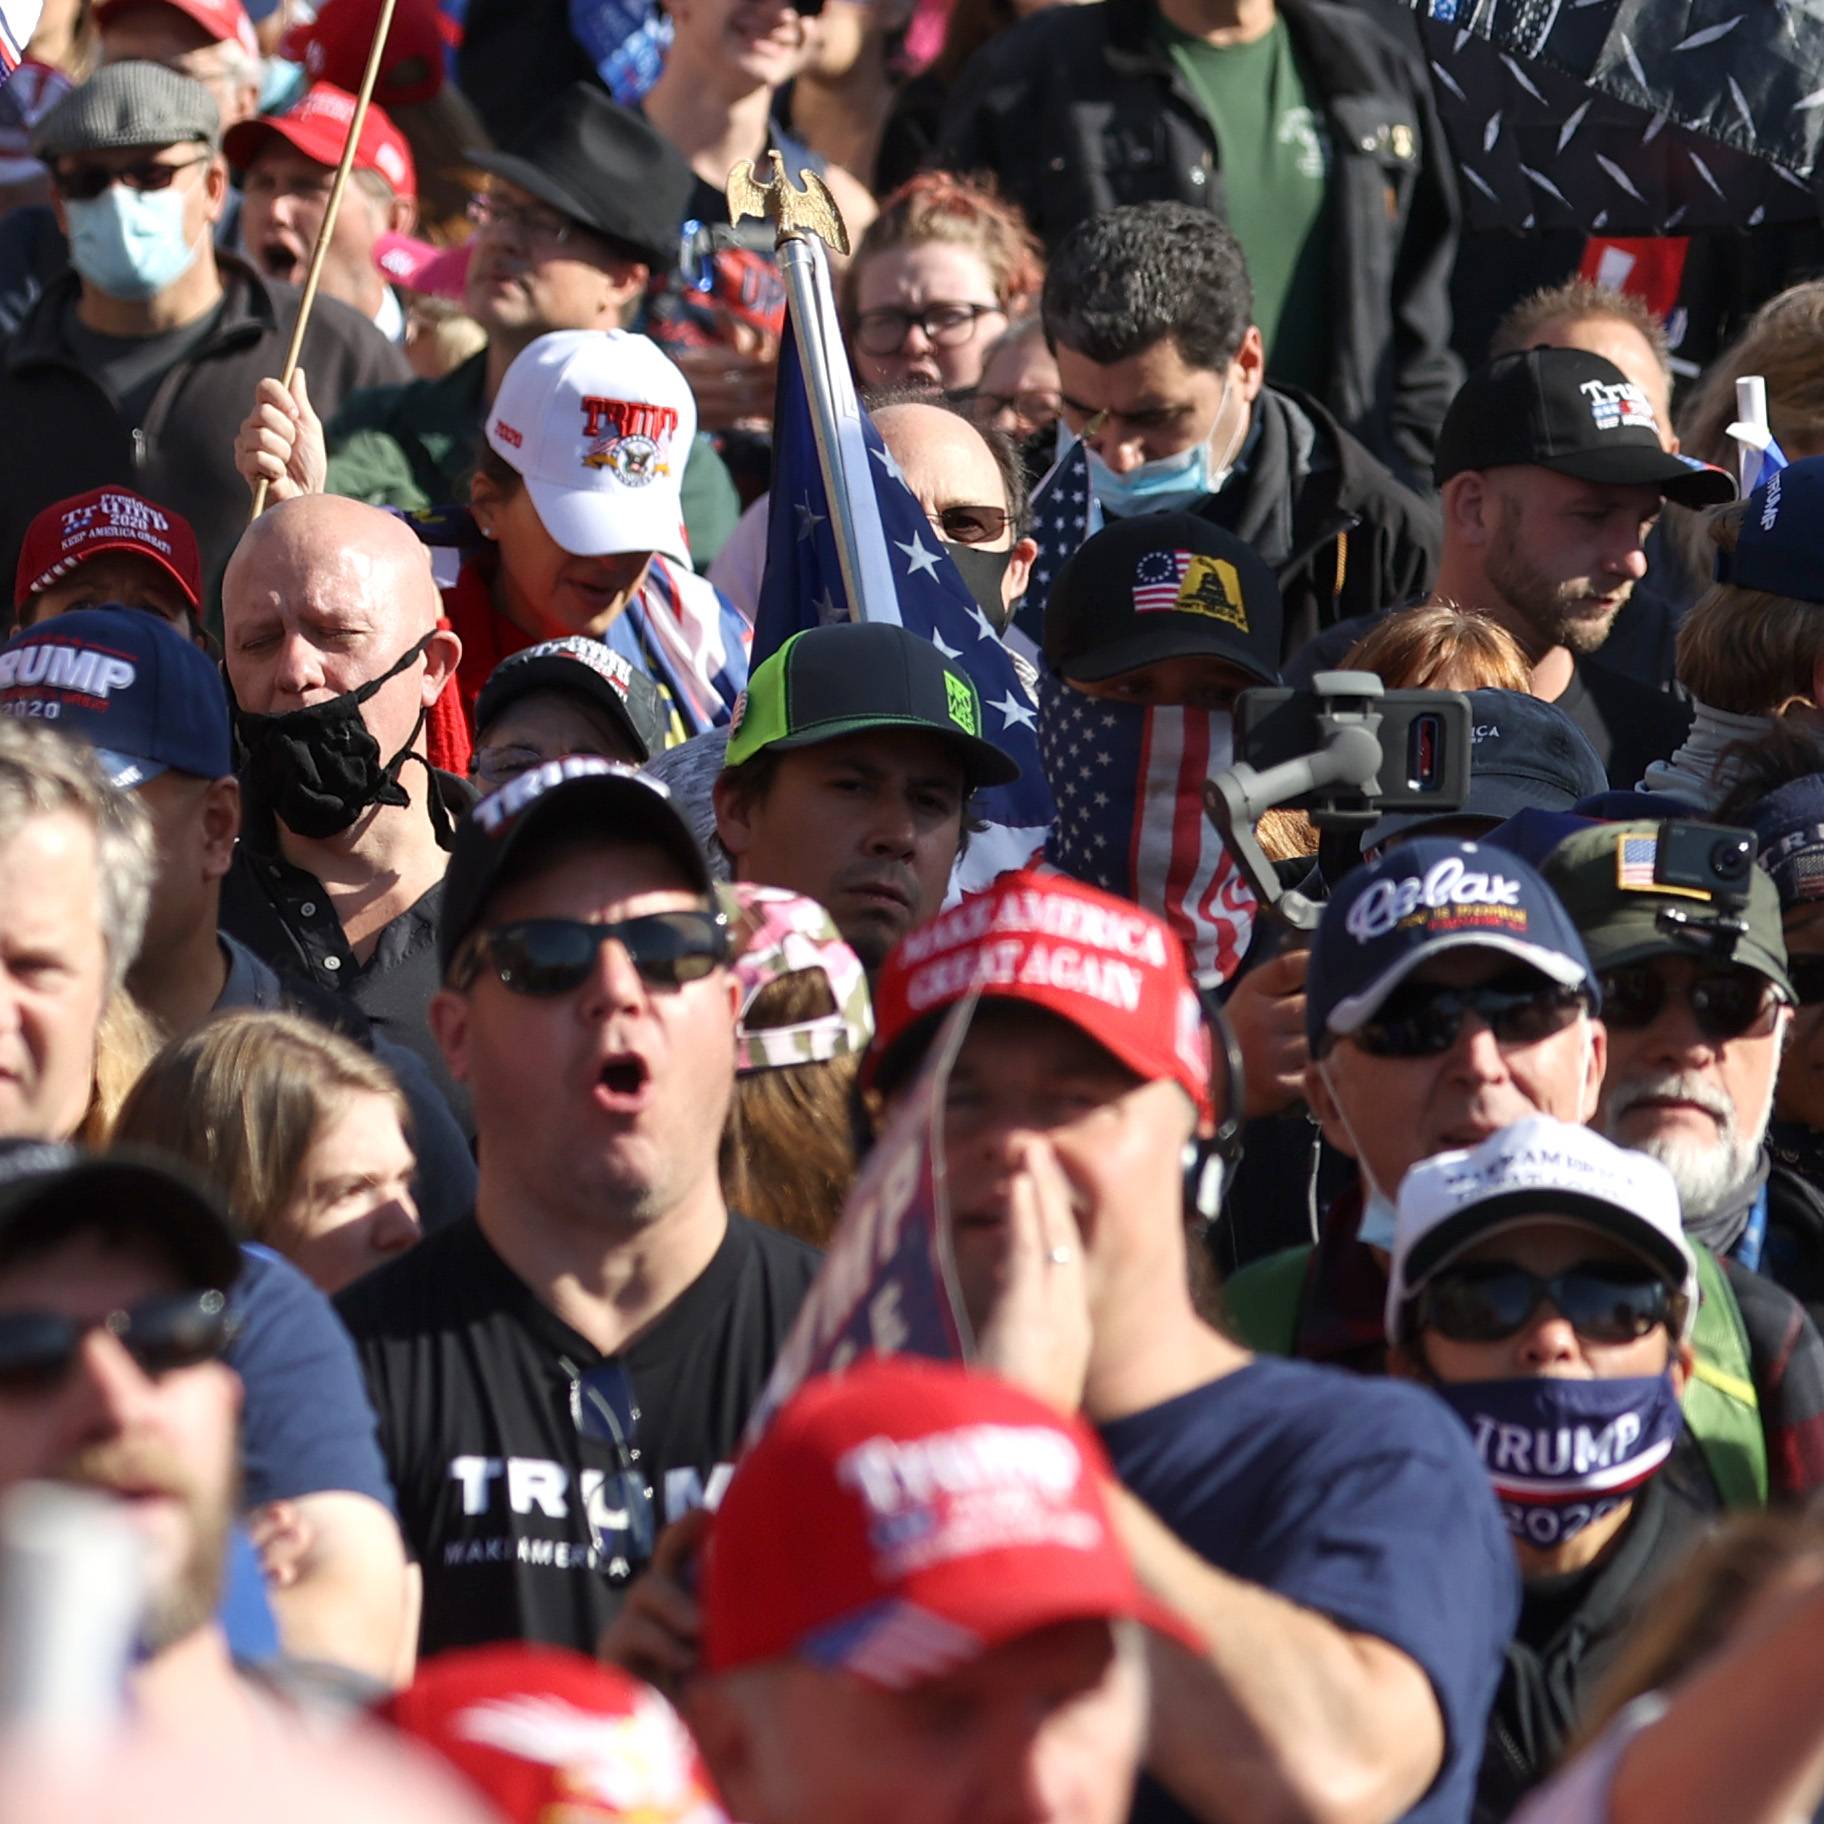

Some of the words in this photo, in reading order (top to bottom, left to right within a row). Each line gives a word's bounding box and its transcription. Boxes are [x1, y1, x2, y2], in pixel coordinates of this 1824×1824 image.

[61, 530, 87, 552] KEEP
[88, 526, 135, 540] AMERICA
[109, 513, 147, 531] 2020
[999, 891, 1167, 969] AMERICA
[1346, 857, 1522, 943] Relax
[1021, 944, 1143, 1013] AGAIN
[1473, 1411, 1642, 1476] TRUMP
